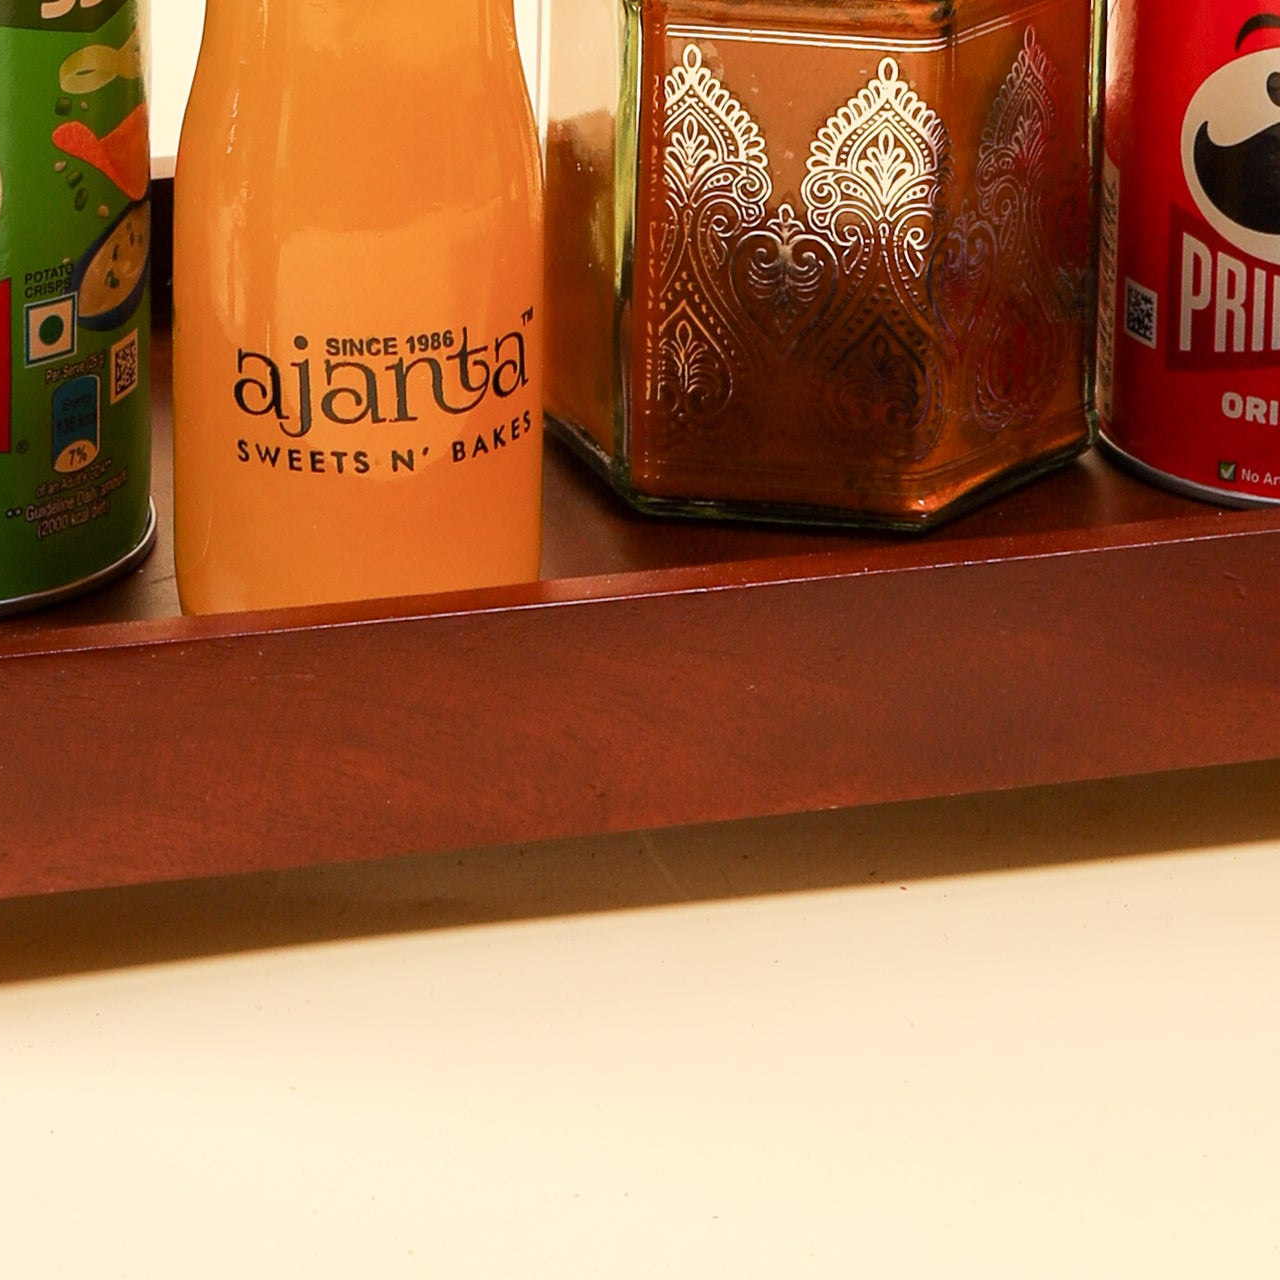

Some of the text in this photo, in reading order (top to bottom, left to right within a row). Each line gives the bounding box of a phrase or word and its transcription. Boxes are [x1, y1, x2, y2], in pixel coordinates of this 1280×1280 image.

[24, 262, 75, 285] POTATO
[24, 277, 73, 298] CRISPS
[325, 330, 454, 357] SINCE 1986
[233, 326, 529, 438] ajanta
[238, 439, 370, 474] SWEETS
[452, 409, 532, 463] BAKES
[67, 443, 89, 467] 7%
[1241, 468, 1260, 484] No
